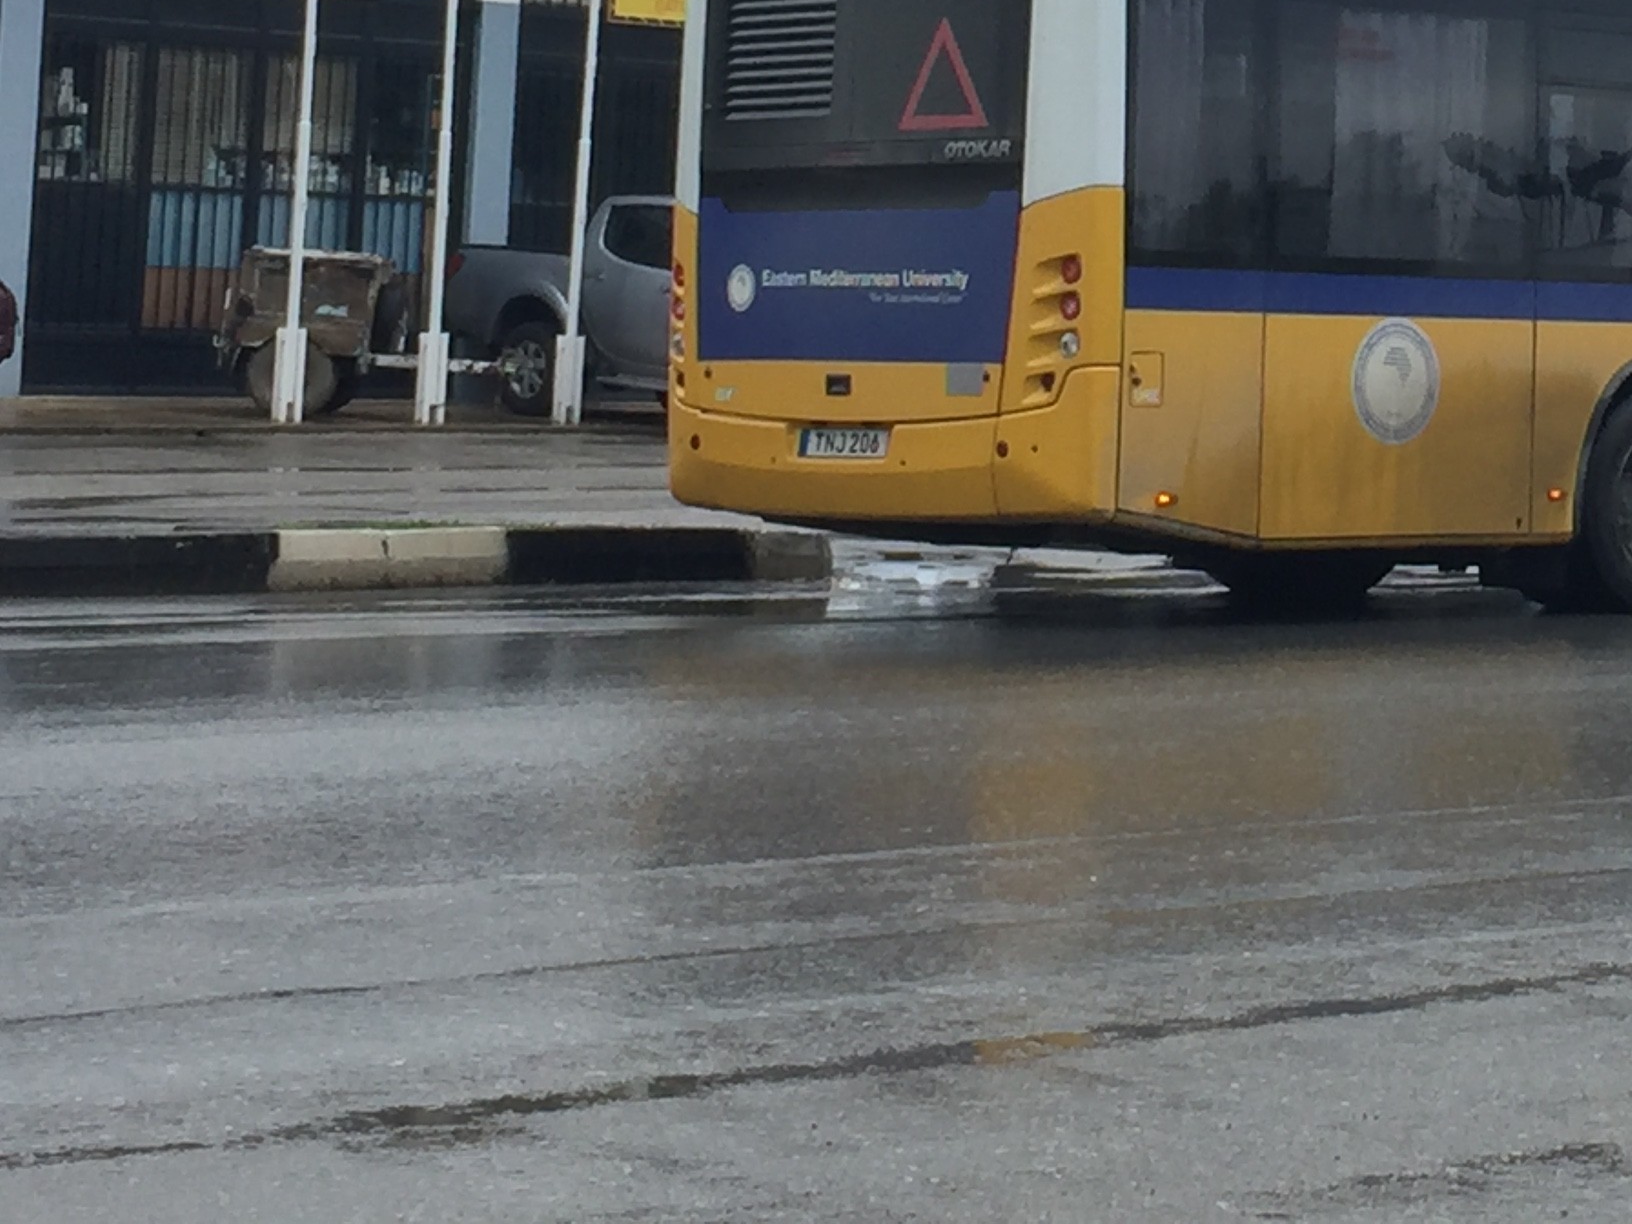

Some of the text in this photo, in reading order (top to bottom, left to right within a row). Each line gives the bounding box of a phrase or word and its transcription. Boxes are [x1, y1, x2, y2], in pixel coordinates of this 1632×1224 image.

[944, 138, 1012, 160] OTOKAR
[762, 268, 808, 287] Eastern
[902, 268, 970, 291] University
